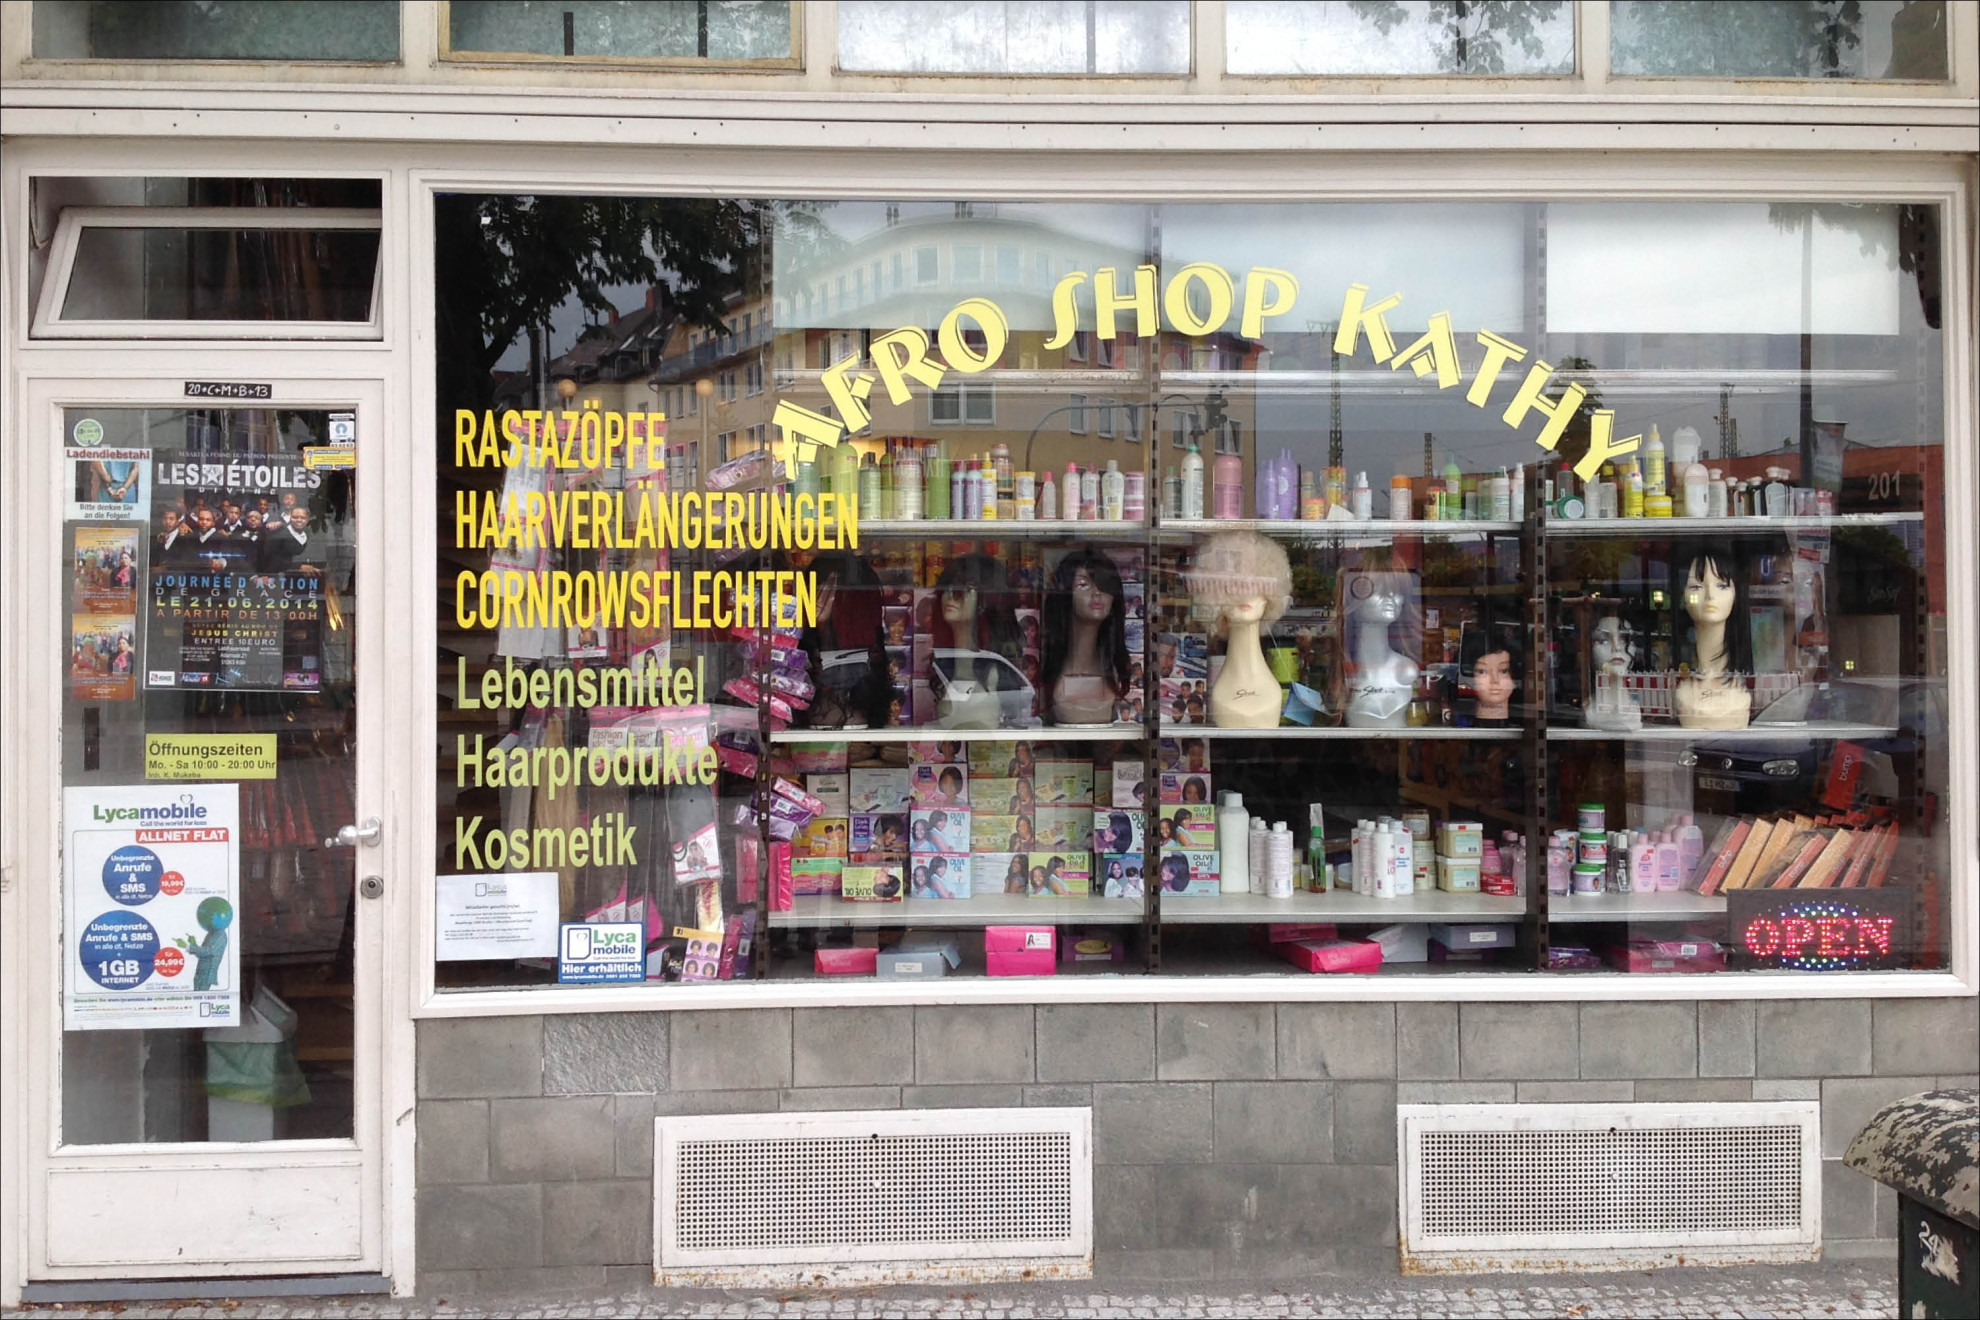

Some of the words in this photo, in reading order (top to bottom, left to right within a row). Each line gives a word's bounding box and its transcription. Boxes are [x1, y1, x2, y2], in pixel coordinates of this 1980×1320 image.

[772, 297, 1009, 481] AFRO
[1044, 261, 1300, 351] SHOP
[1333, 282, 1643, 483] KATHY
[455, 399, 666, 469] RASTAZÖPFE
[66, 449, 150, 460] Ladendiebstahl
[158, 463, 200, 486] LES
[226, 459, 322, 489] ÉTOILES
[1868, 470, 1901, 501] 201
[106, 512, 131, 520] Folgen!
[456, 481, 859, 549] HAARVERLÄNGERUNGEN
[156, 596, 181, 607] LE
[190, 596, 318, 610] 21.06.2014
[456, 570, 817, 629] CORNROWSFLECHTEN
[173, 608, 230, 619] PARTIR
[238, 610, 258, 620] DE
[458, 656, 704, 709] Lebensmittel
[149, 741, 263, 758] Öffnungszeiten
[149, 760, 166, 769] Mo.
[176, 760, 189, 769] Sa
[192, 760, 218, 769] 10:00
[228, 760, 255, 769] 20:00
[257, 760, 276, 769] Uhr
[456, 731, 719, 800] Haarprodukte
[1838, 755, 1852, 781] bump
[93, 803, 207, 823] Lycamobile
[138, 830, 190, 842] ALLNET
[193, 830, 226, 841] FLAT
[456, 813, 638, 870] Kosmetik
[114, 863, 152, 872] Anrufe
[128, 873, 137, 882] &
[120, 883, 146, 893] SMS
[90, 923, 148, 932] Unbegrenzte
[85, 934, 118, 942] Anrufe
[130, 933, 153, 941] SMS
[593, 929, 636, 943] Lyca
[1745, 918, 1893, 956] OPEN
[593, 945, 636, 955] mobile
[98, 959, 140, 976] 1GB
[154, 958, 184, 966] 24,99€
[562, 964, 585, 974] Hier
[588, 962, 641, 973] erhältlich
[212, 1003, 230, 1011] Lyca
